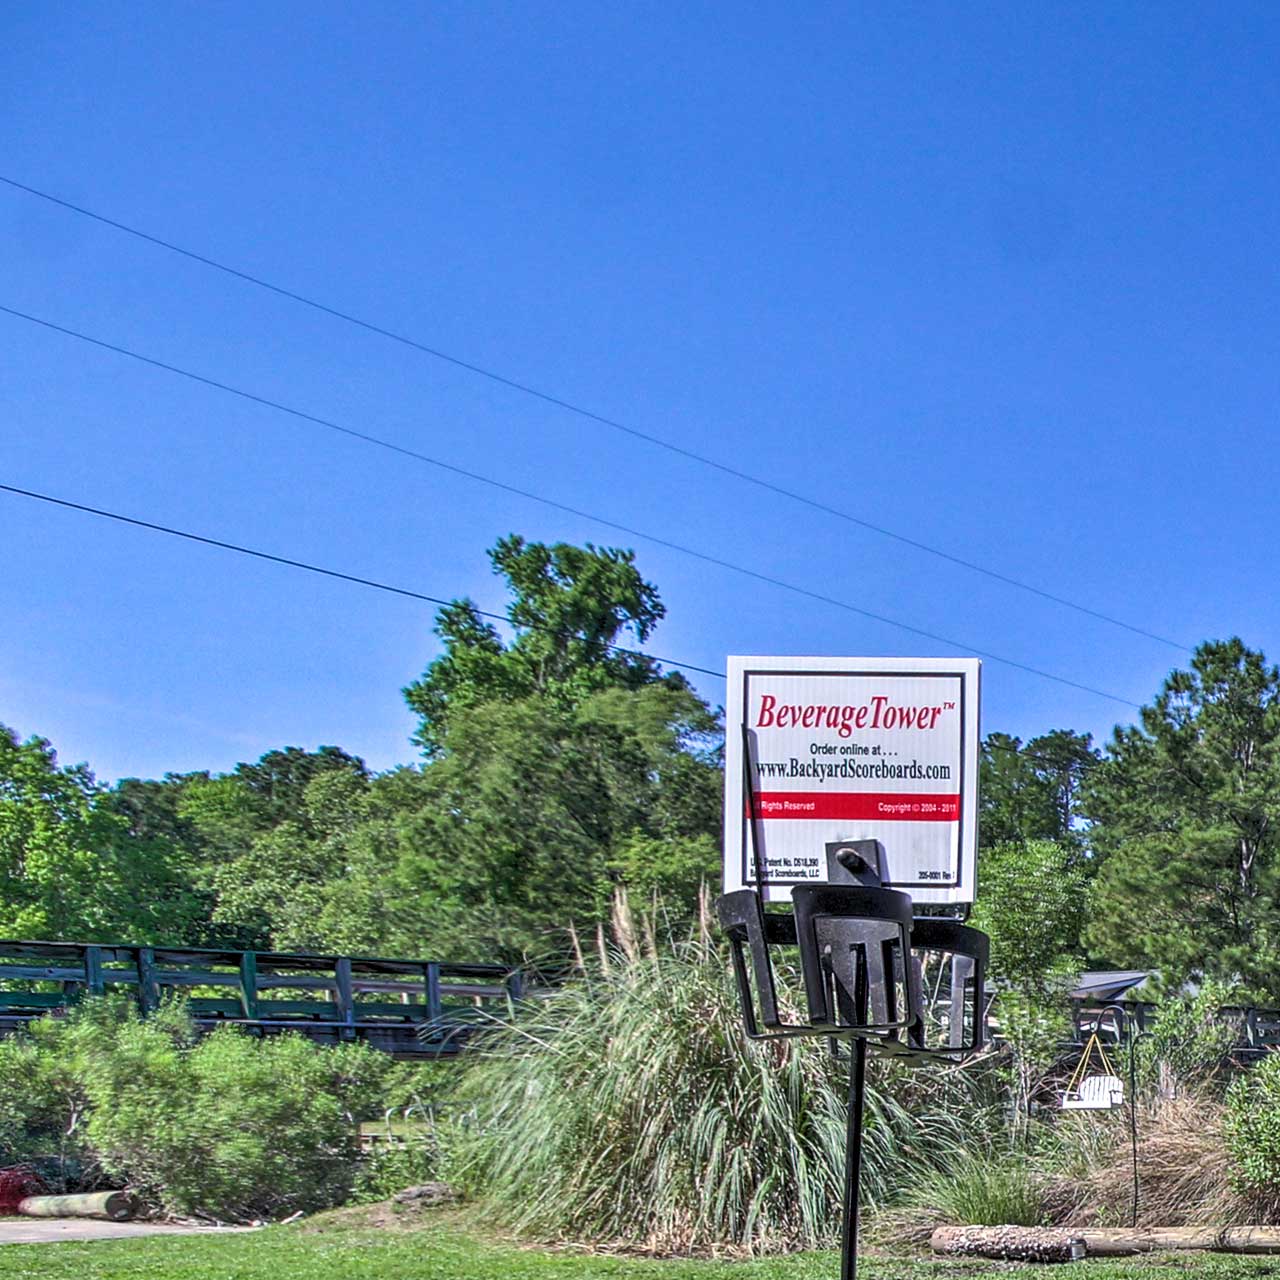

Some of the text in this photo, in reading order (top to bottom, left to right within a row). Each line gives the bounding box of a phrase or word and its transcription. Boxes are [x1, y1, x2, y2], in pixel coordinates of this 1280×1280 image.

[810, 743, 837, 756] Order
[840, 743, 869, 757] online
[756, 758, 951, 783] www.BackyardScoreboards.com
[761, 800, 783, 812] Rights
[784, 800, 815, 811] Reserved
[878, 802, 911, 814] Copyright
[921, 803, 936, 812] 2004
[764, 858, 782, 867] Patent
[809, 869, 820, 878] LLC
